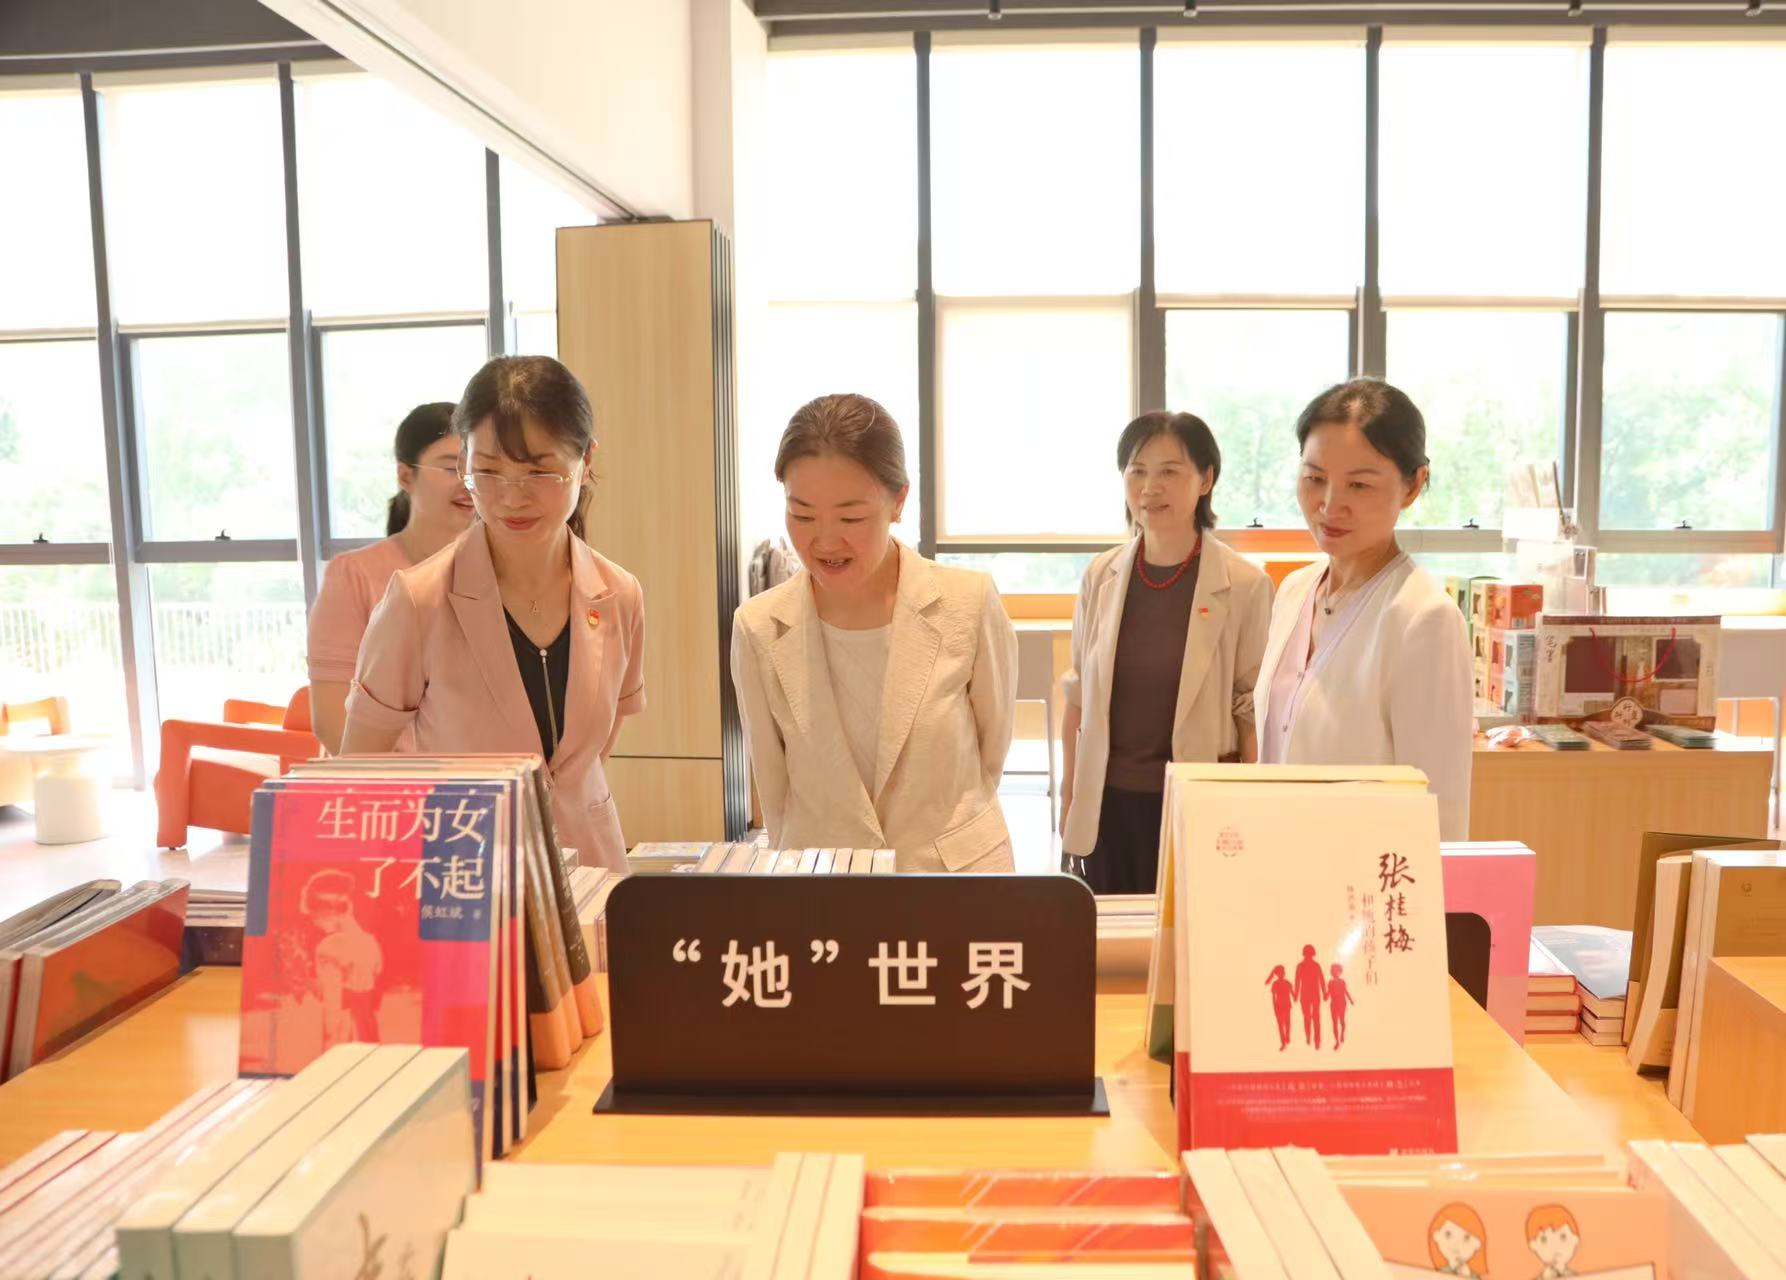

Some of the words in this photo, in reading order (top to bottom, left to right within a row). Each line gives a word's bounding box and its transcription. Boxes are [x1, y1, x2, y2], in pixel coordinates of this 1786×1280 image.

[316, 796, 488, 843] 生而为女
[359, 855, 485, 901] 了不起
[1378, 852, 1416, 954] 张桂梅
[672, 938, 1031, 1010] “她”世界
